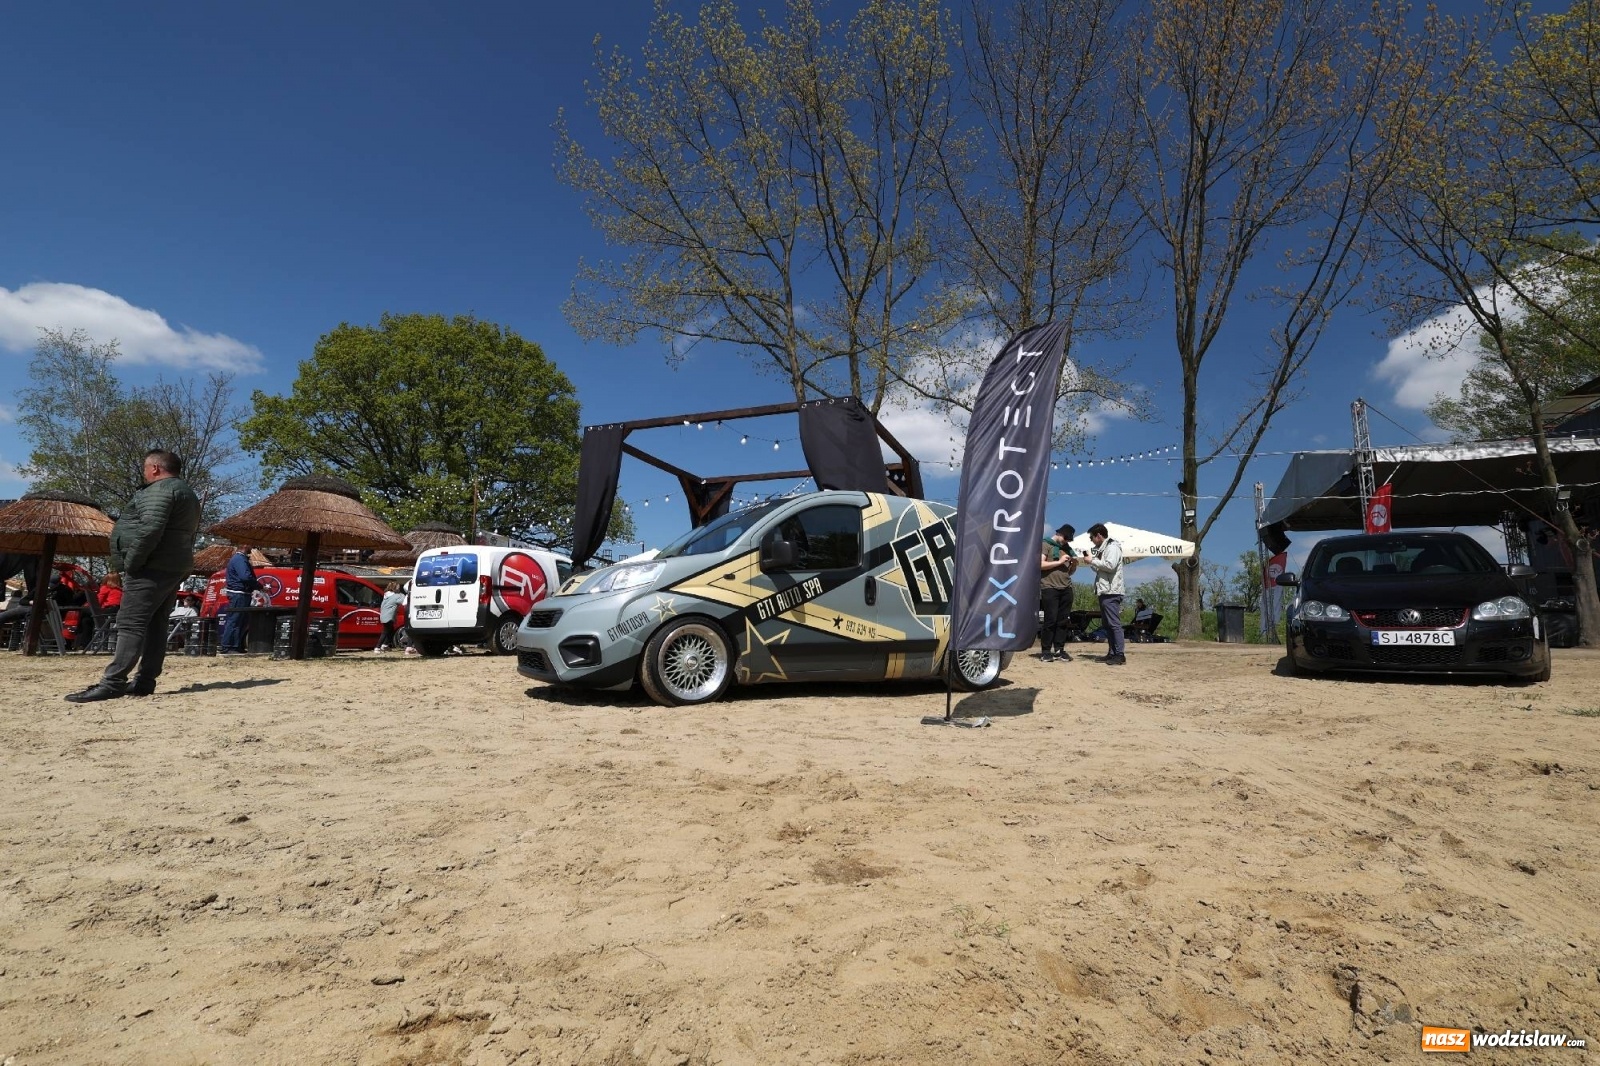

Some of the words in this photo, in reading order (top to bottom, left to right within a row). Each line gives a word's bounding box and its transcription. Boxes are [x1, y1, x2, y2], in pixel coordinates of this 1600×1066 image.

[1149, 545, 1183, 554] OKOCIM
[757, 598, 776, 620] GTI
[776, 586, 802, 612] AUTO
[802, 577, 823, 599] SPA
[607, 611, 651, 642] GTIAUTOSPA
[1381, 633, 1398, 643] SJ
[1405, 633, 1450, 643] 4878C
